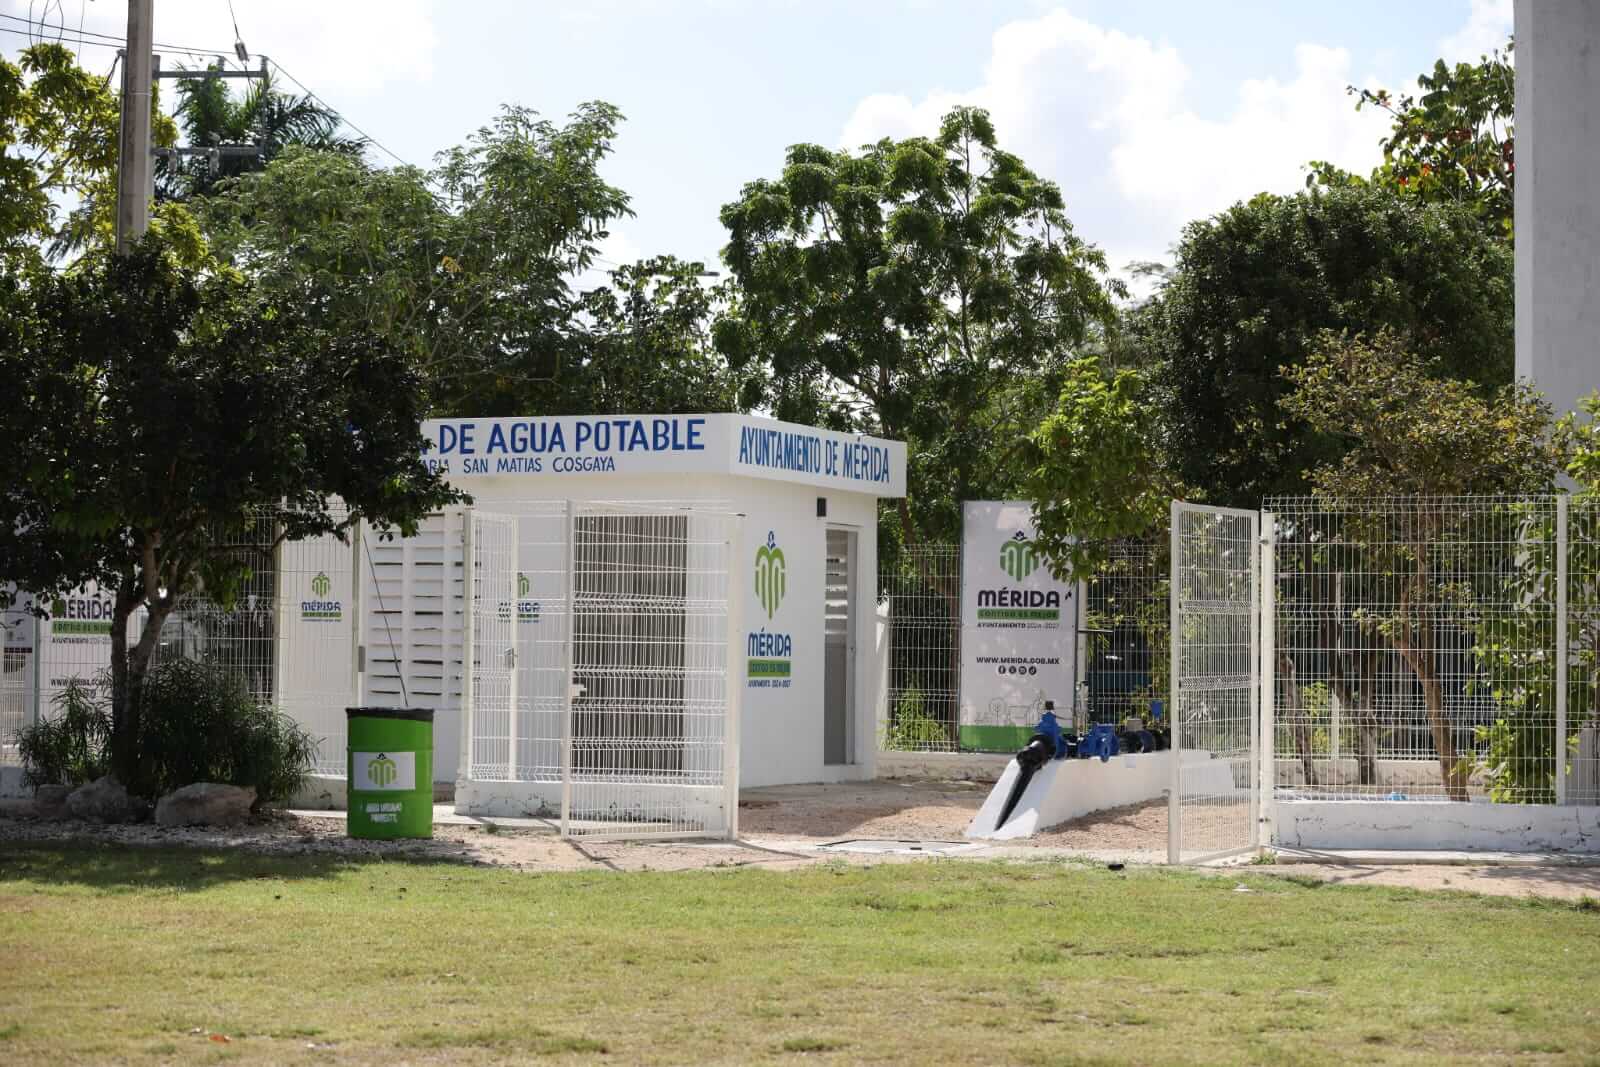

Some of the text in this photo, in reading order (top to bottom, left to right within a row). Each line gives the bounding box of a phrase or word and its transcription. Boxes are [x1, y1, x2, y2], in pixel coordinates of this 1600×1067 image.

[439, 423, 475, 455] DE
[486, 421, 566, 454] AGUA
[575, 418, 706, 452] POTABLE
[463, 458, 488, 474] SAN
[497, 457, 542, 473] MATIAS
[552, 456, 615, 473] COSGAYA
[738, 425, 890, 483] AYUNTAMIENTO DE MÉRIDA
[978, 587, 1060, 607] MÉRIDA
[748, 626, 791, 656] MÉRIDA
[976, 657, 1060, 665] WWW.MERIDA.GOB.MX
